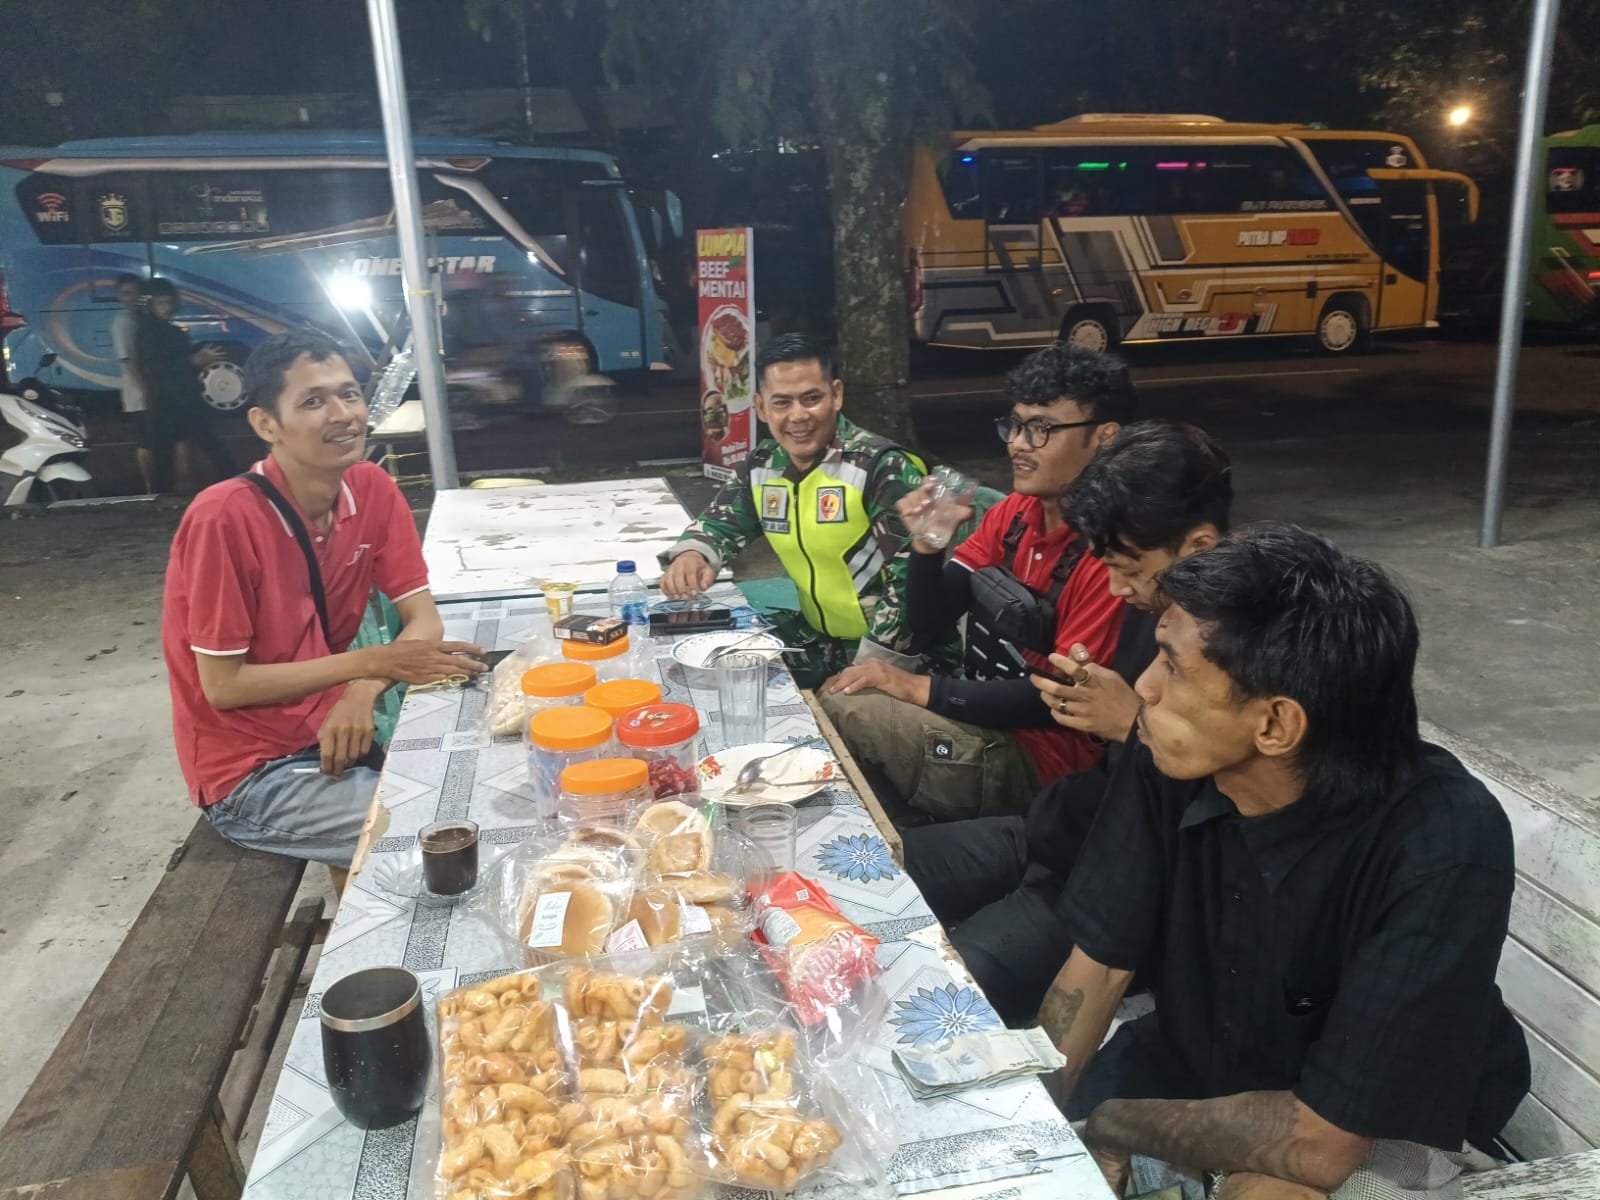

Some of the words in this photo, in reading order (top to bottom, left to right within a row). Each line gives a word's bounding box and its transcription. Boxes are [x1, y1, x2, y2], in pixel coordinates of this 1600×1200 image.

[698, 233, 745, 256] LUMPIA
[699, 261, 730, 278] BEEF
[699, 280, 745, 298] MENTAI
